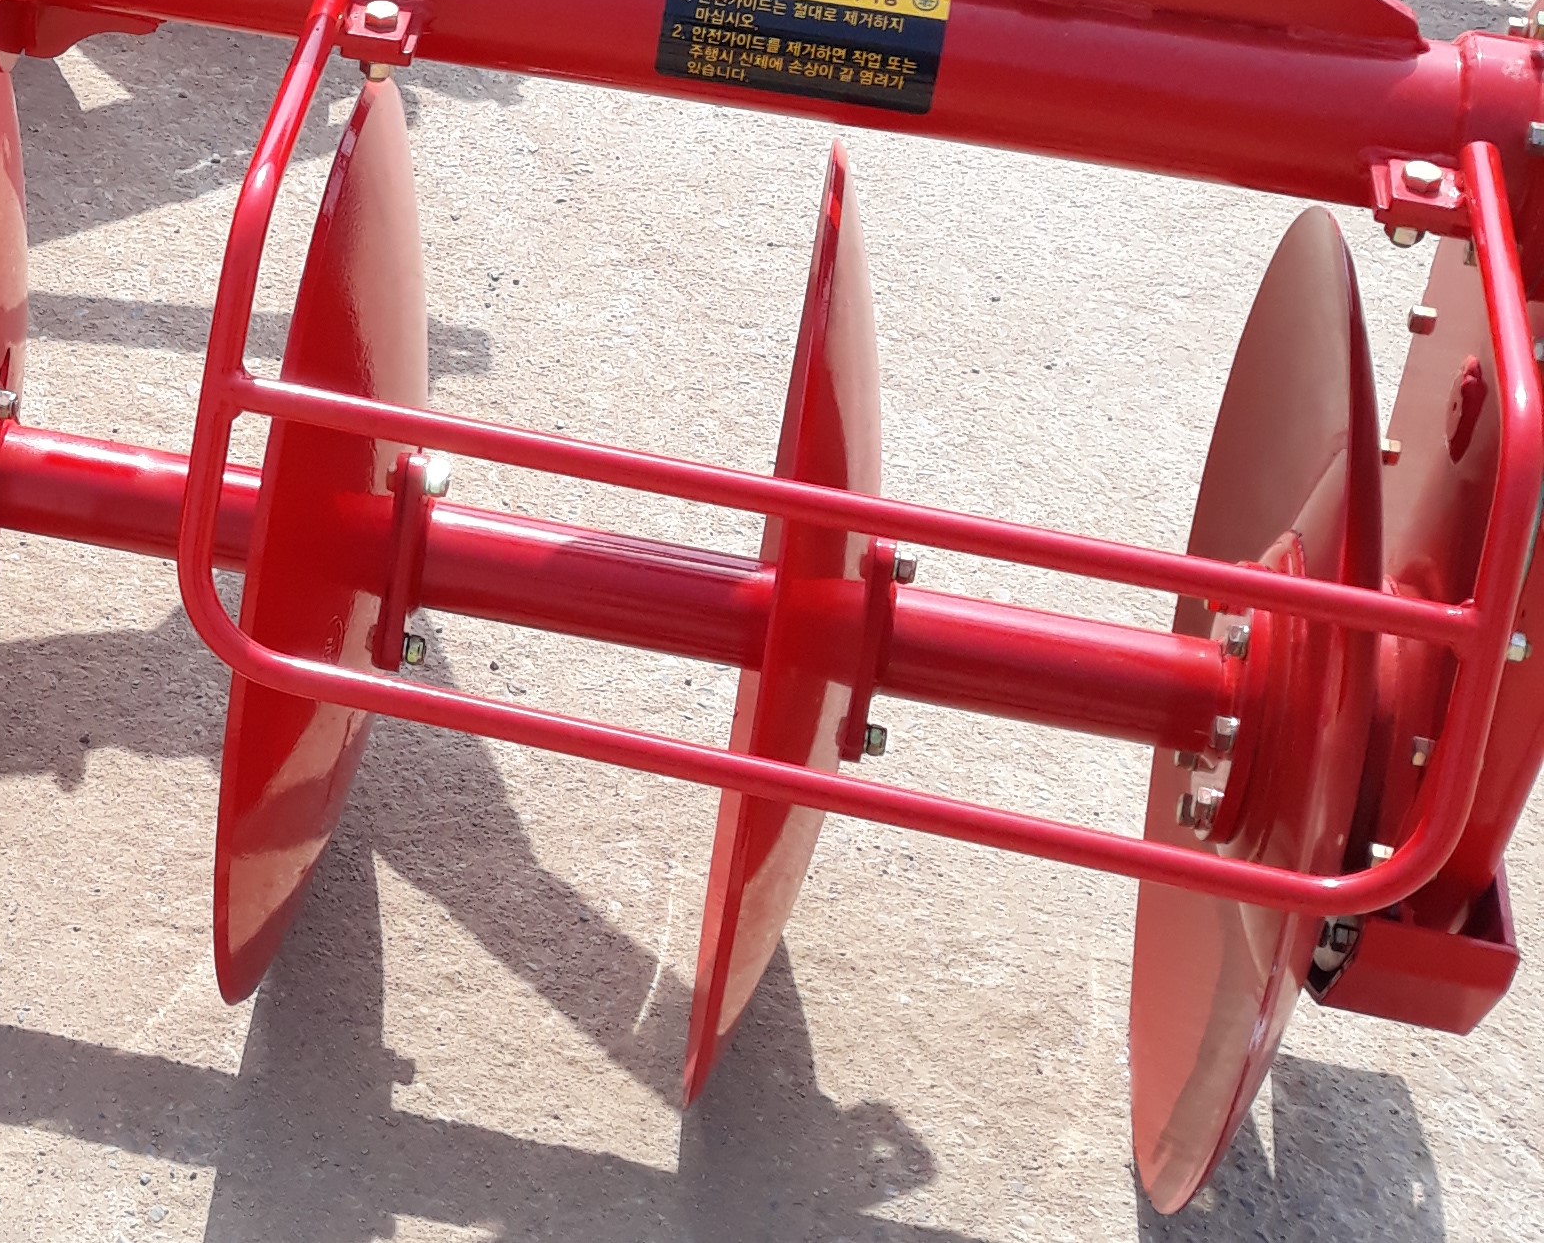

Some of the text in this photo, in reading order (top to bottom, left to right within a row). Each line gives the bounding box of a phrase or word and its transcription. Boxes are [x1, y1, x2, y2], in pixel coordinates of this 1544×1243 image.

[695, 7, 758, 31] 마십시오.
[793, 2, 837, 22] 절대로
[843, 10, 904, 33] 제거하지
[671, 23, 917, 74] 2. 안전가이드를 제거하면 작업 또는
[686, 61, 749, 83] 있습니다.
[688, 44, 904, 90] 주행시 신체에 손상이 갈 염려가
